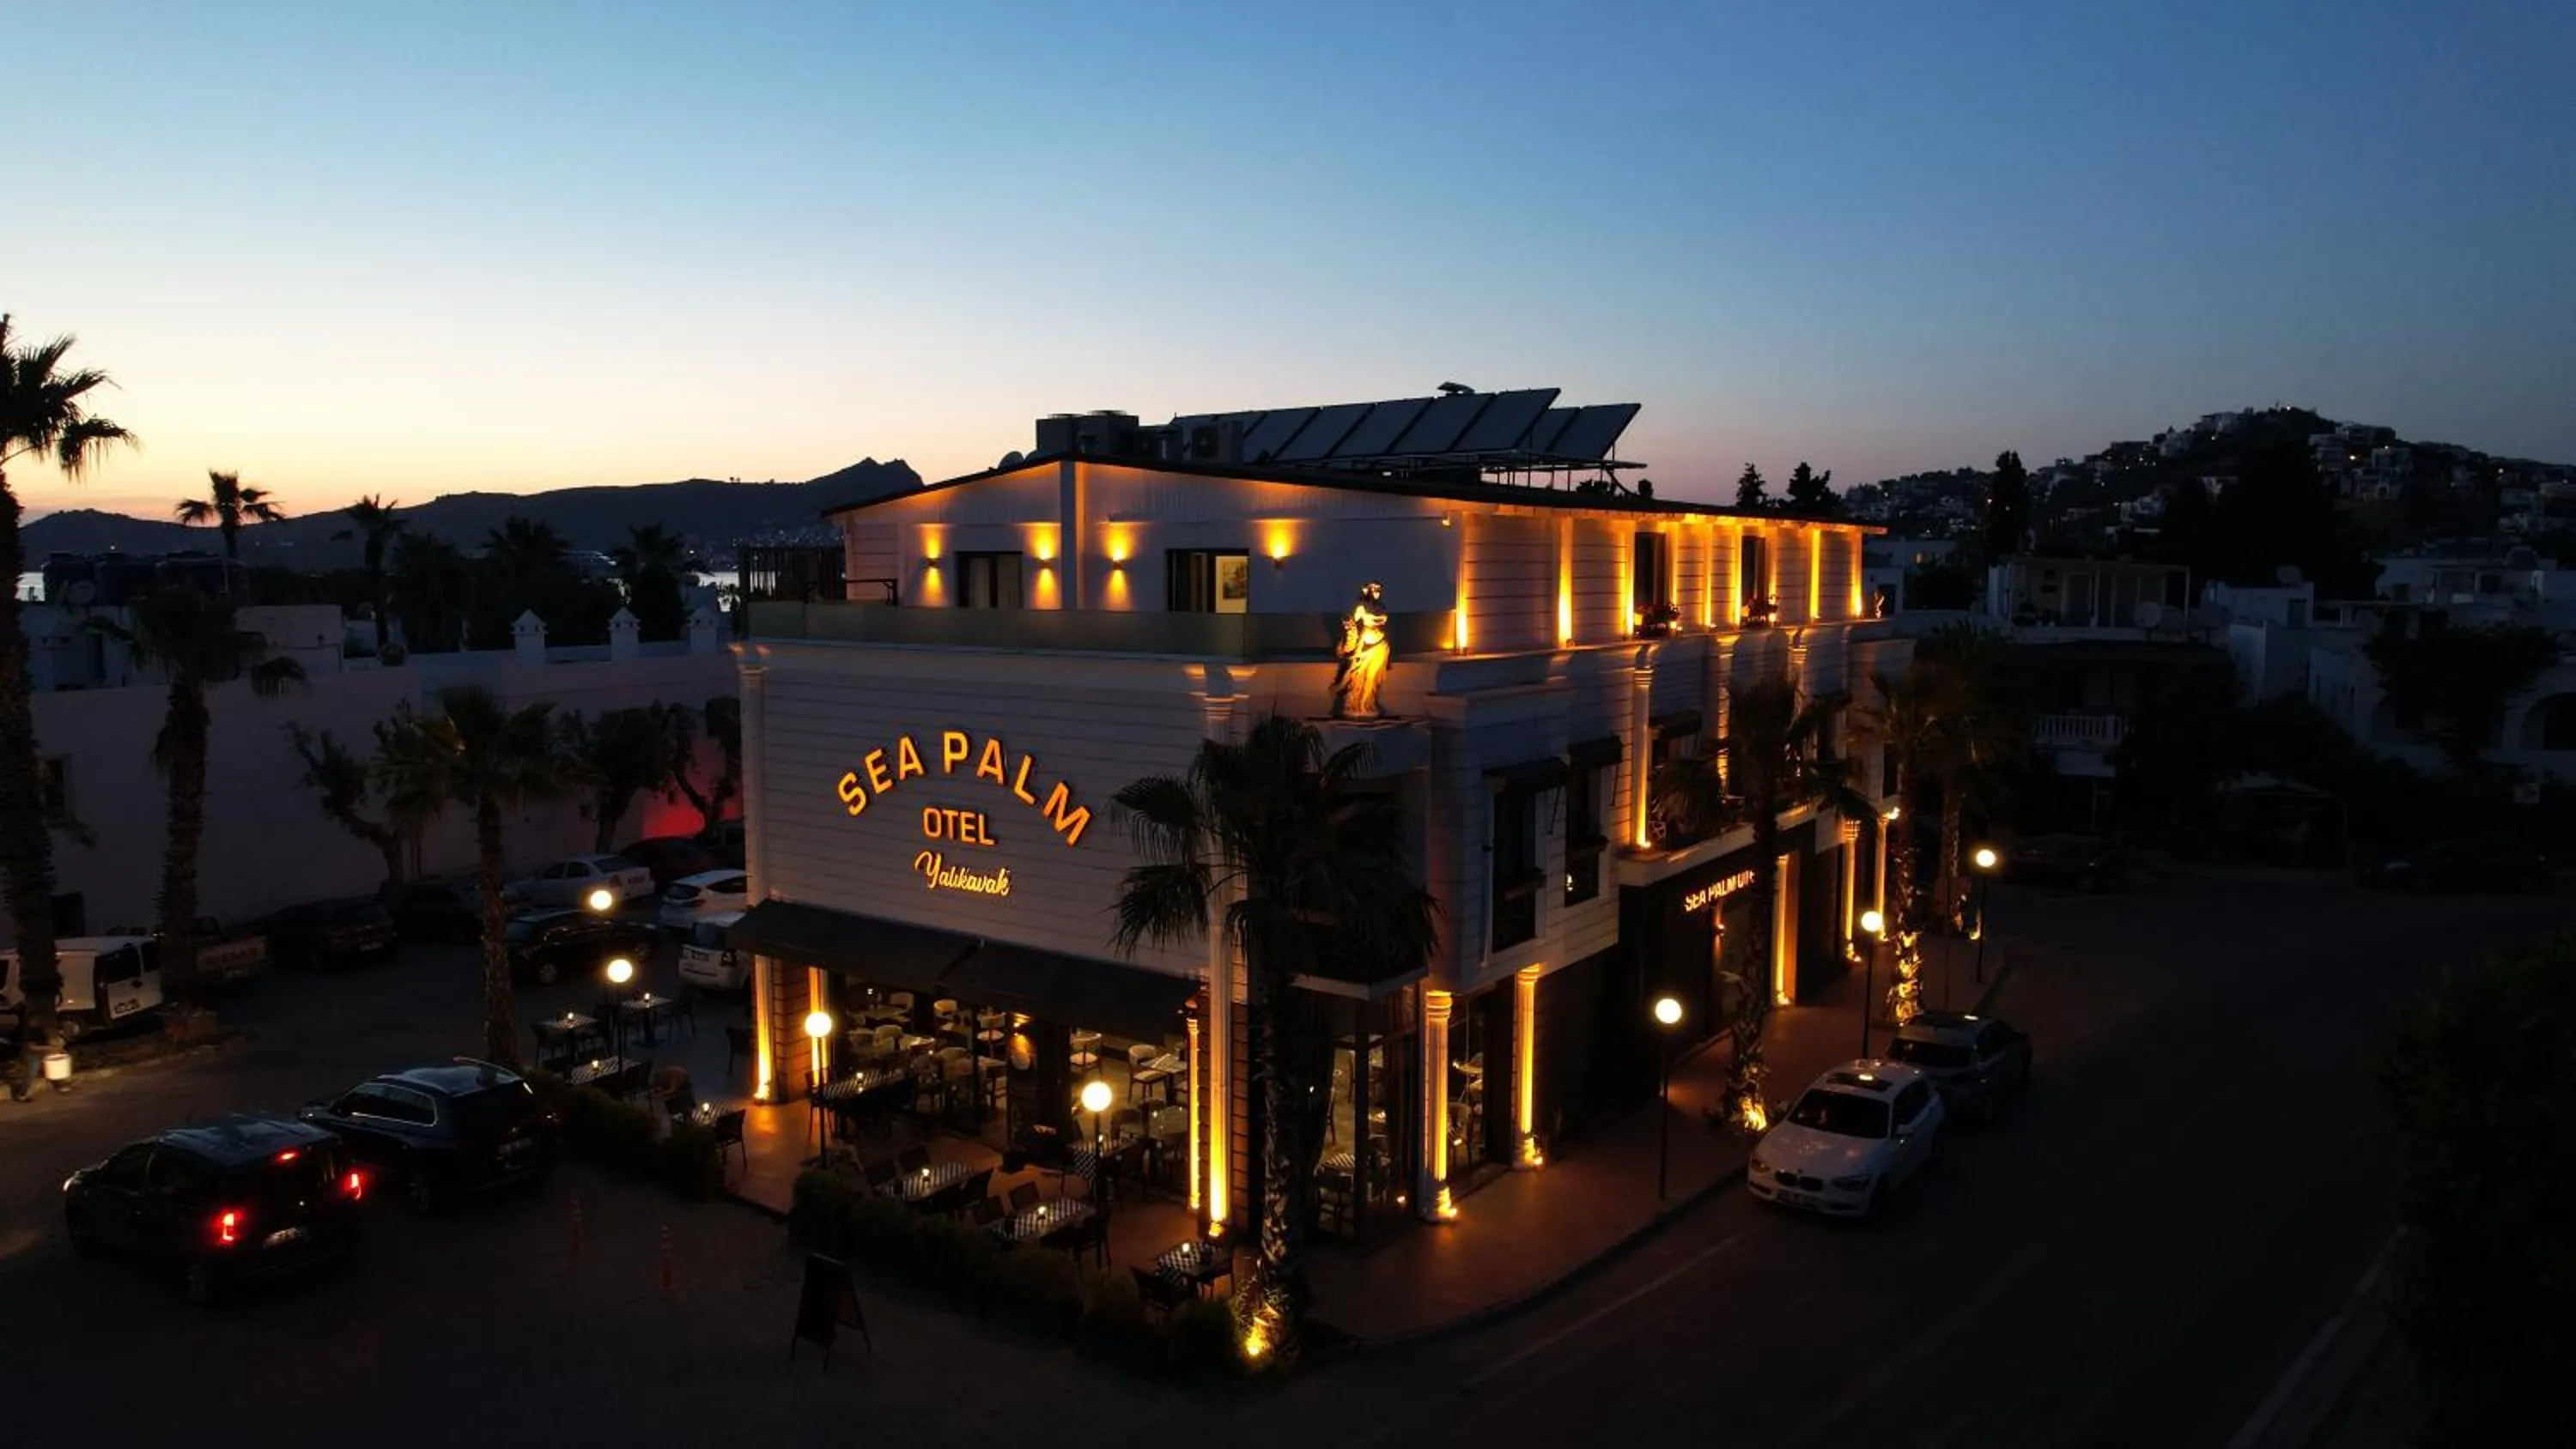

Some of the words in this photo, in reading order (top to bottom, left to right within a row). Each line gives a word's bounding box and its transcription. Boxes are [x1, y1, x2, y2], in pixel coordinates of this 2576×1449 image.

[837, 731, 927, 817] SEA
[942, 730, 1092, 847] PALM
[921, 807, 999, 846] OTEL
[1684, 889, 1707, 912] SEA
[1708, 876, 1738, 902] PALM
